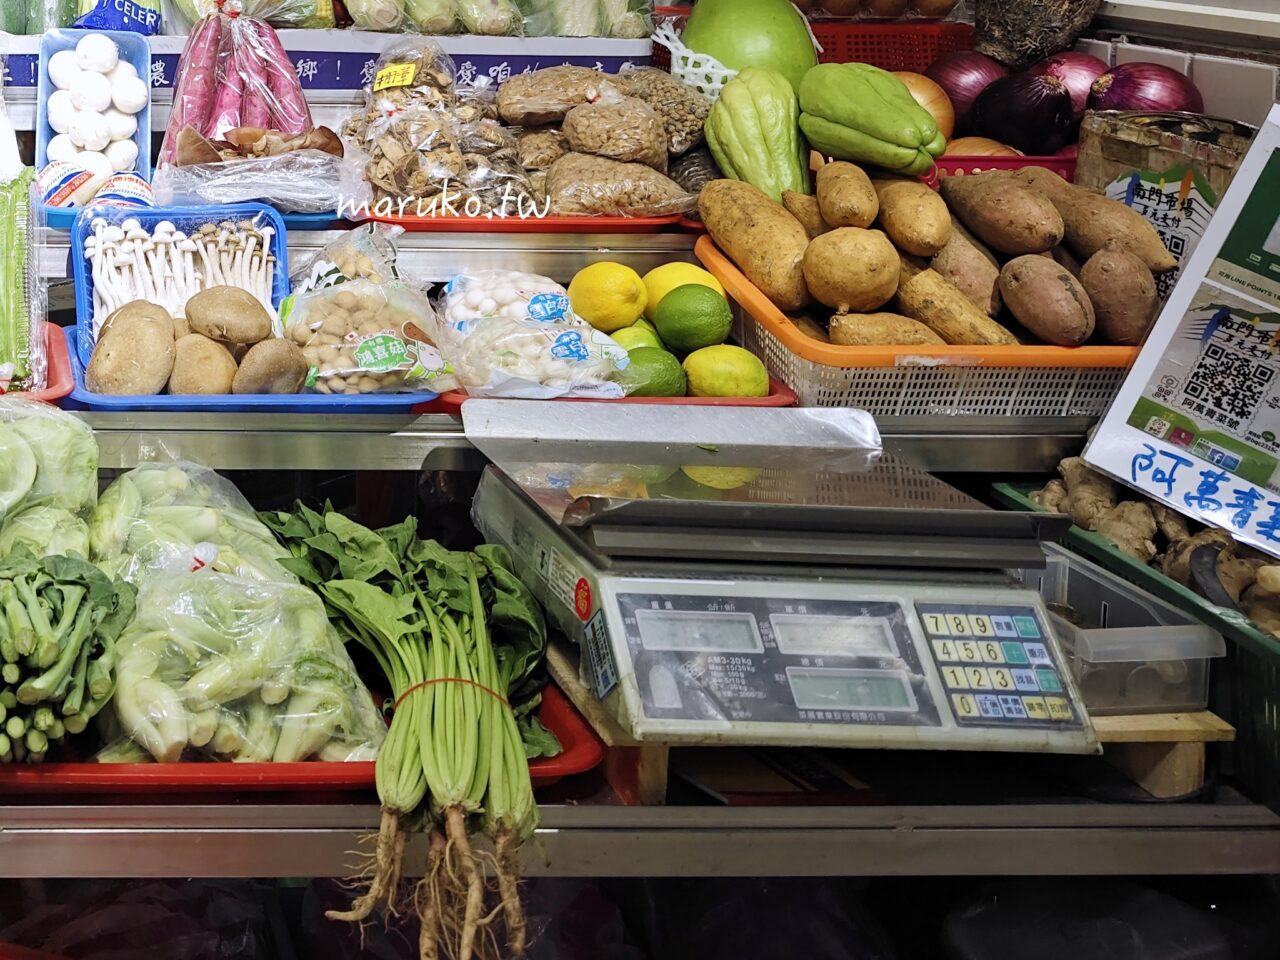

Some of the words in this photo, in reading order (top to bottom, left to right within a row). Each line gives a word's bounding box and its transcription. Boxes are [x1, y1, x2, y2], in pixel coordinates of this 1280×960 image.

[1133, 181, 1195, 218] 南門市場
[1230, 275, 1246, 287] LINE
[1246, 281, 1273, 298] POINTS
[1220, 316, 1280, 354] 南門市
[357, 340, 406, 365] 鴻喜菇
[1223, 334, 1273, 361] 多元支付
[1181, 397, 1241, 431] 阿萬青菜號
[929, 615, 940, 633] 7
[953, 616, 965, 633] 8
[975, 617, 988, 633] 9
[941, 642, 952, 659] 4
[962, 642, 975, 660] 5
[986, 643, 998, 661] 6
[949, 669, 960, 687] 1
[972, 669, 986, 687] 2
[995, 669, 1008, 688] 3
[959, 696, 971, 714] 0
